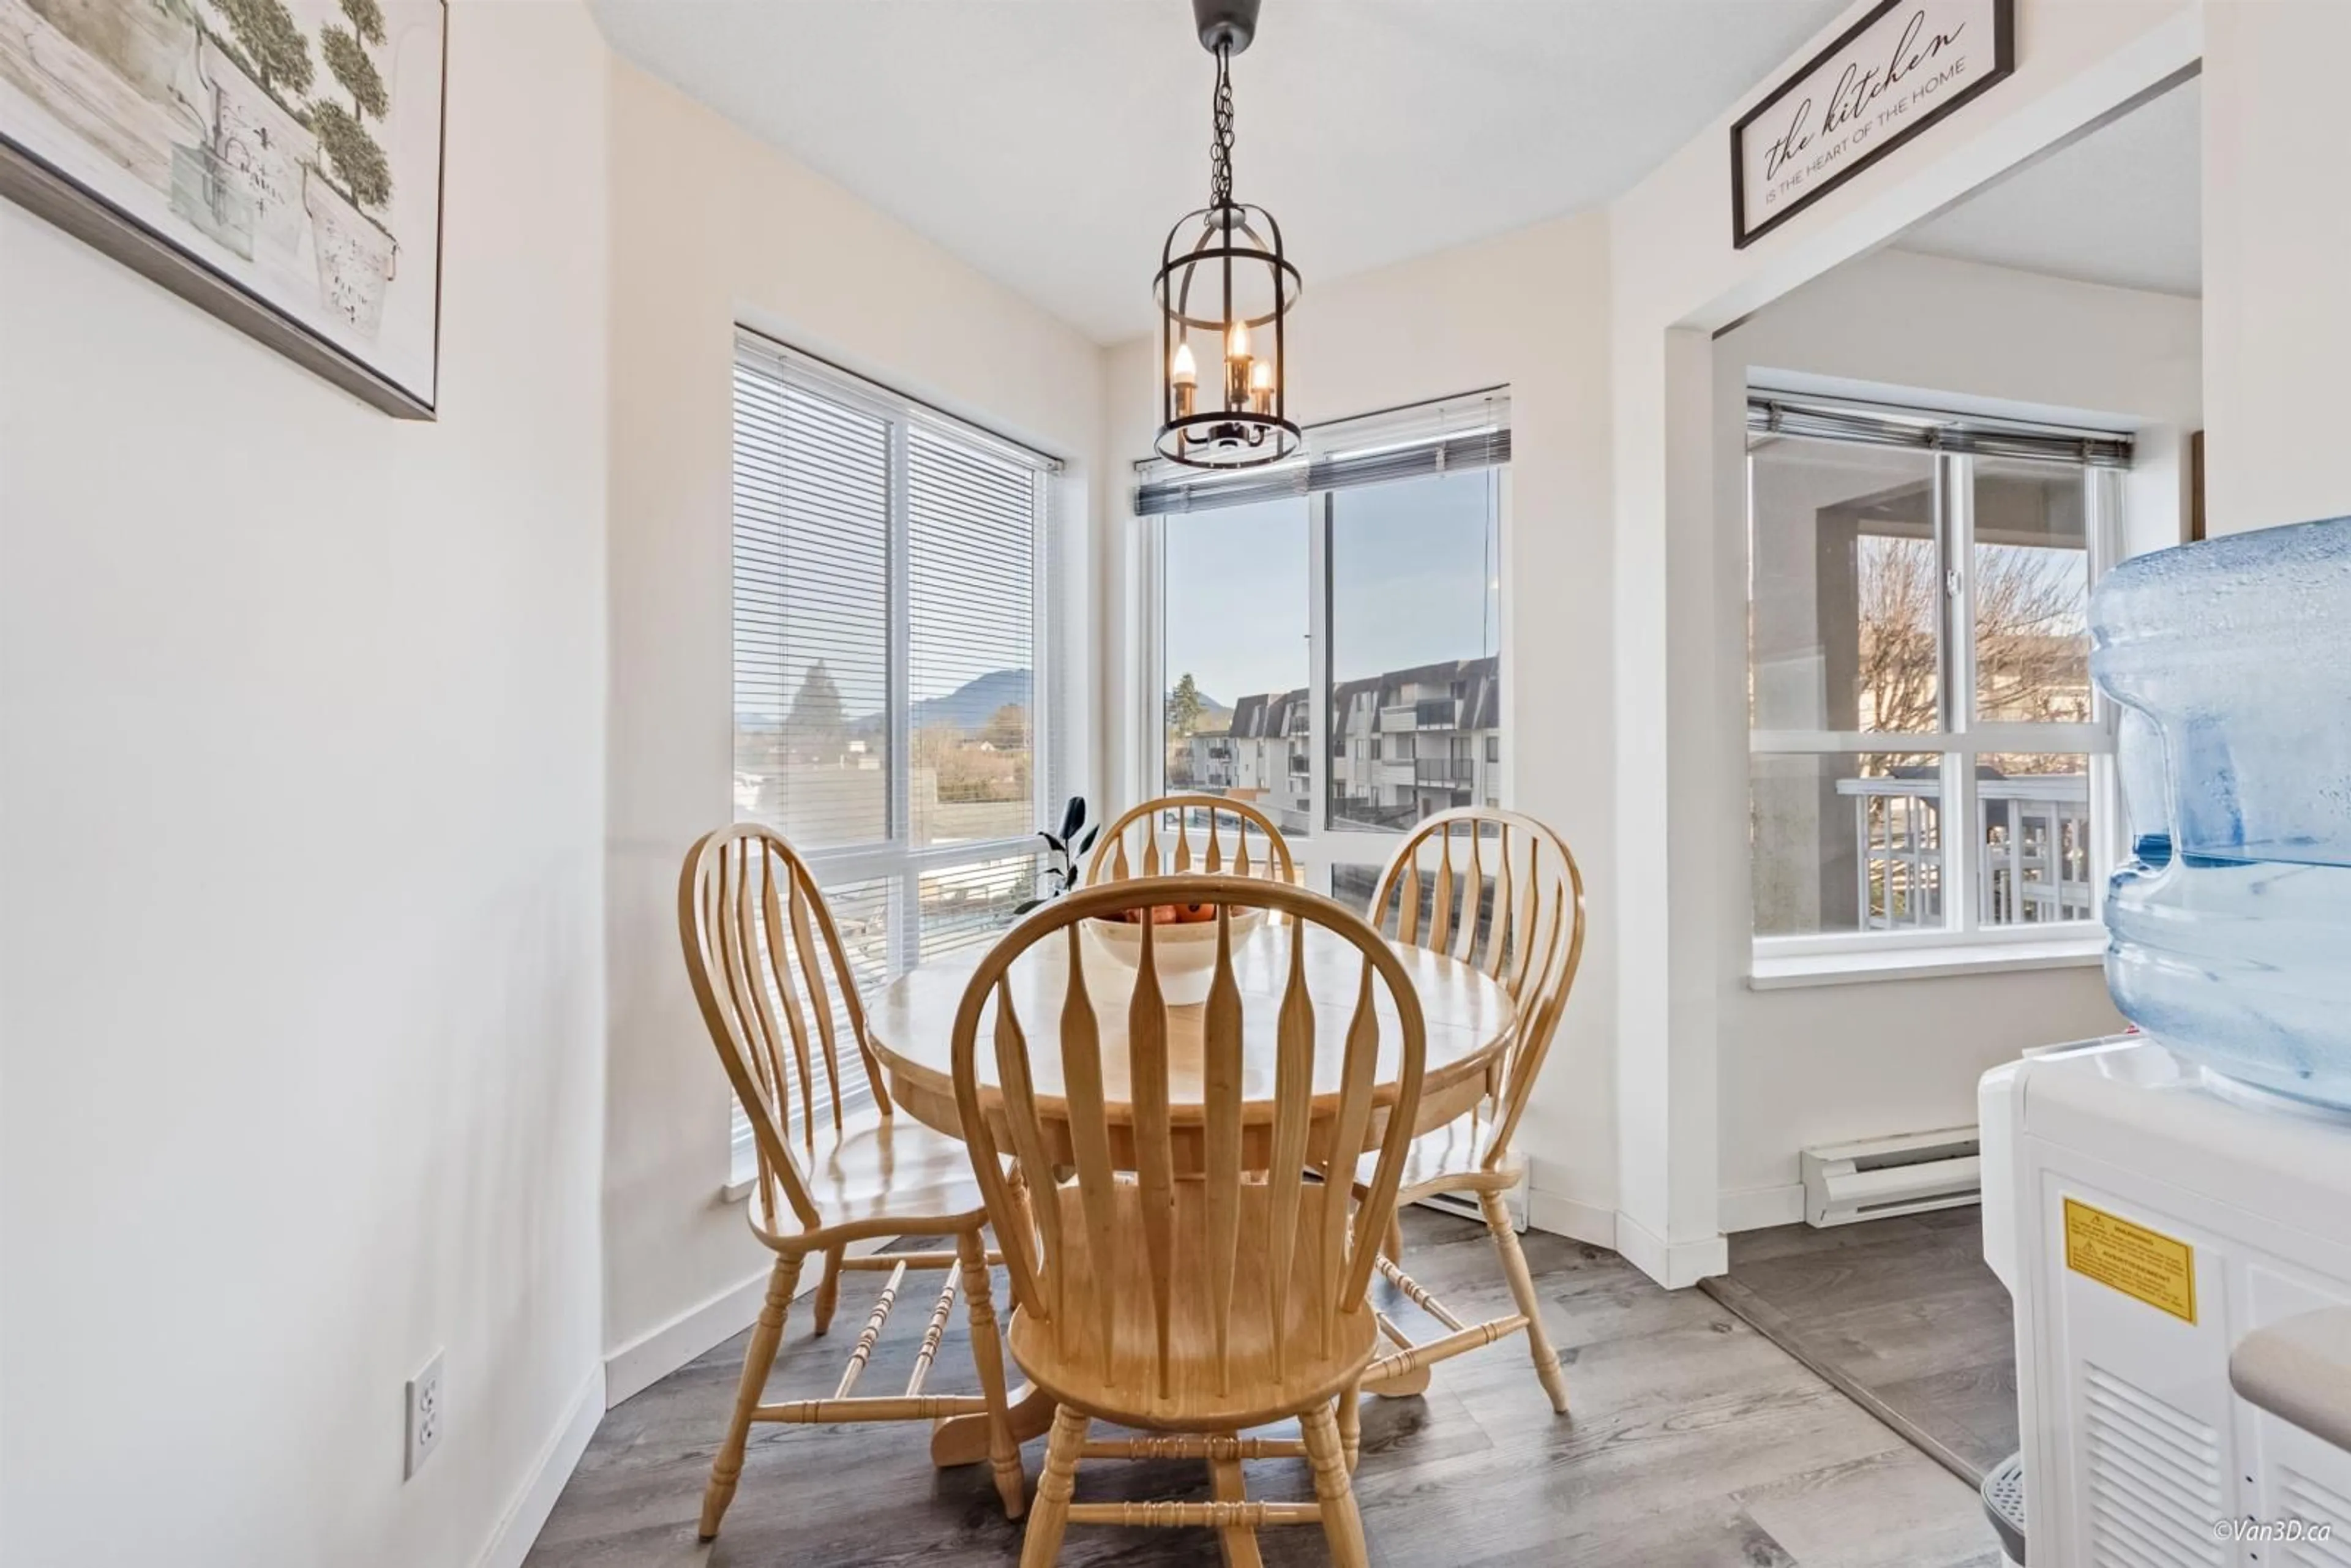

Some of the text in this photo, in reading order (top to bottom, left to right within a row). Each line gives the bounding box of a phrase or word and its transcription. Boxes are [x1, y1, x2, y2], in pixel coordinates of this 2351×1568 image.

[1765, 10, 1965, 181] the kitchen
[1766, 56, 1965, 205] IS THE HEART OF THE HOME
